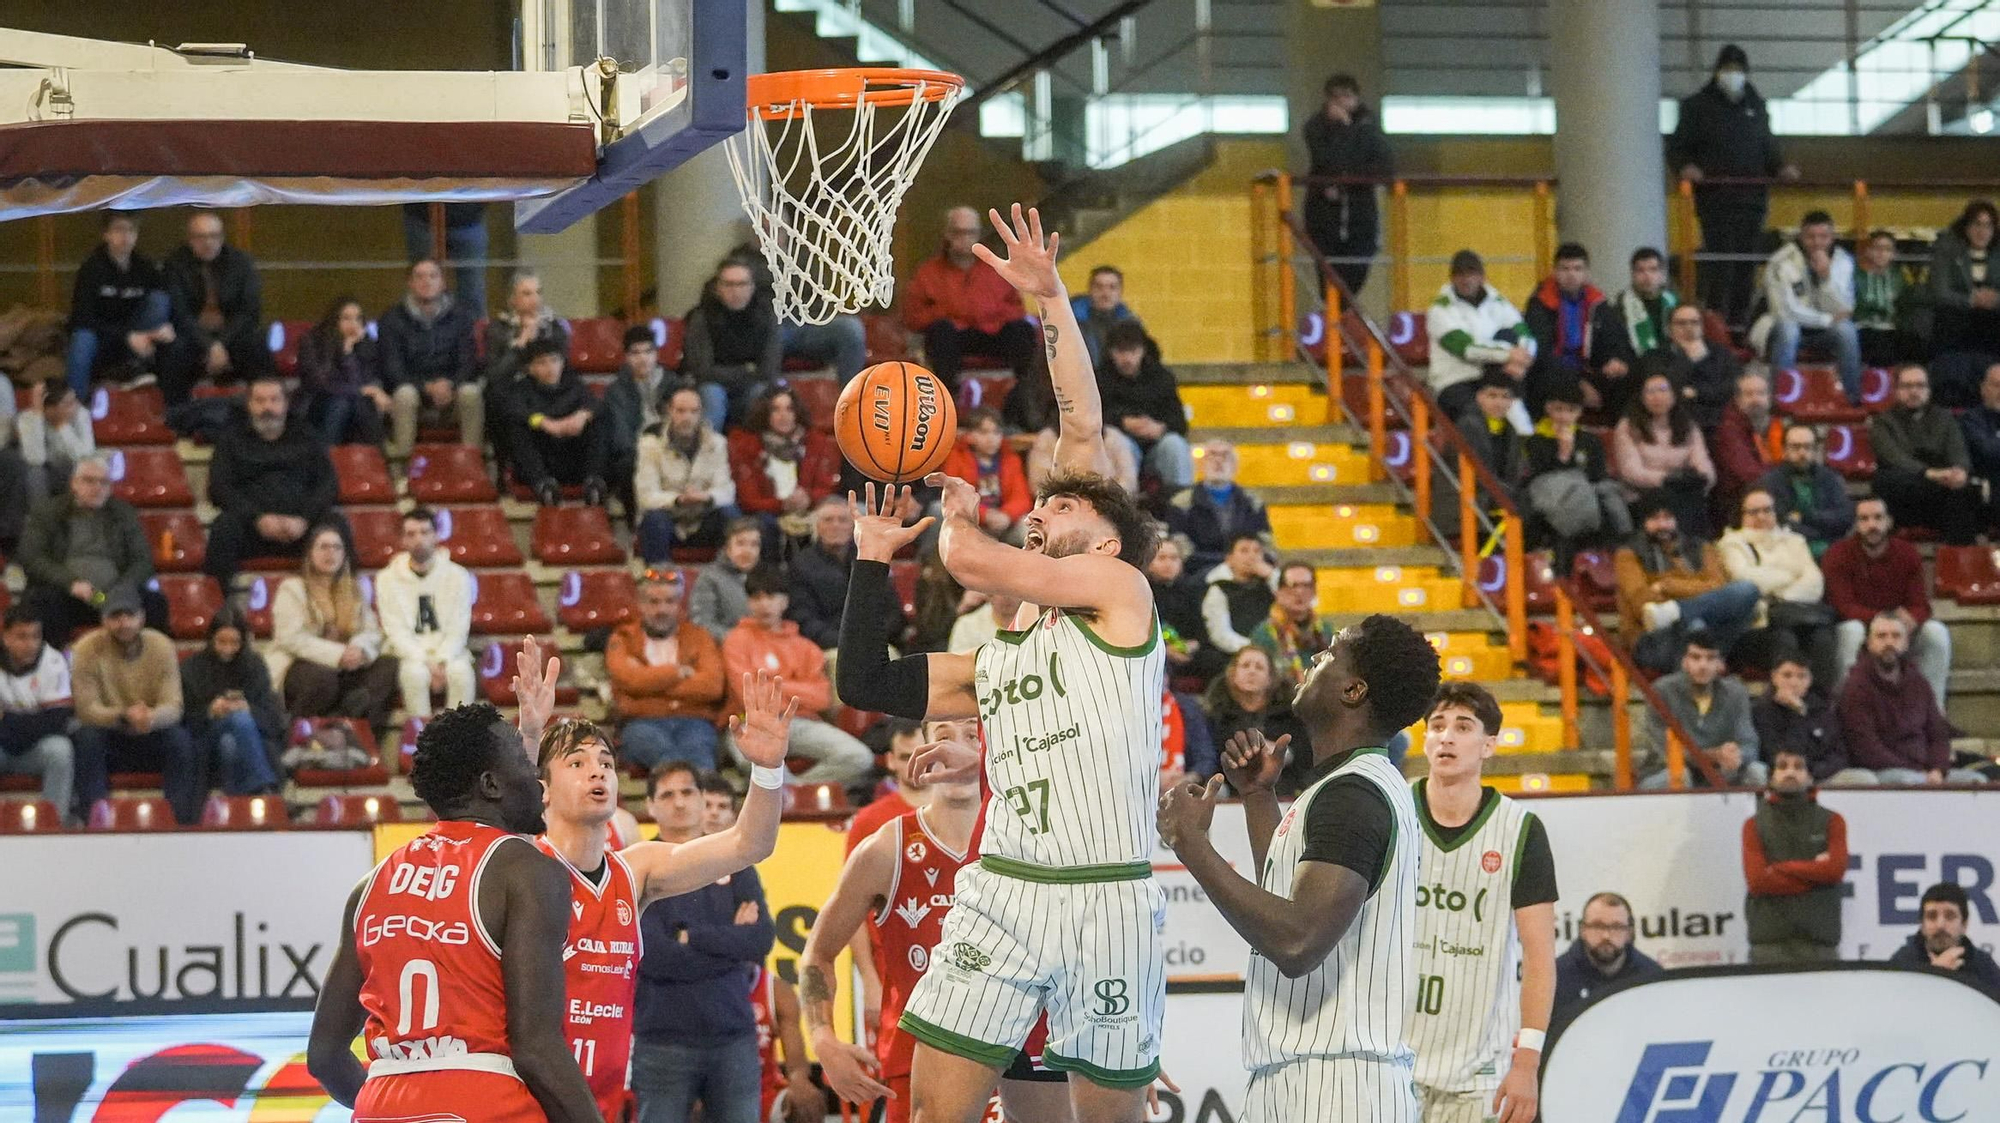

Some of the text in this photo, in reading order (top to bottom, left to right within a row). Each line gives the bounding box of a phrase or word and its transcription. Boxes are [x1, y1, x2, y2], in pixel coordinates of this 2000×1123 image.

[911, 375, 937, 451] Wilson
[414, 595, 440, 634] A
[1023, 722, 1081, 753] Cajasol
[48, 912, 321, 1001] Cualix
[577, 938, 634, 954] CAJA RURAL
[1440, 940, 1485, 958] Cajasol
[1416, 974, 1444, 1016] 10
[573, 1038, 595, 1077] 11
[1768, 1048, 1860, 1068] GRUPO
[1741, 1059, 1990, 1123] PACC
